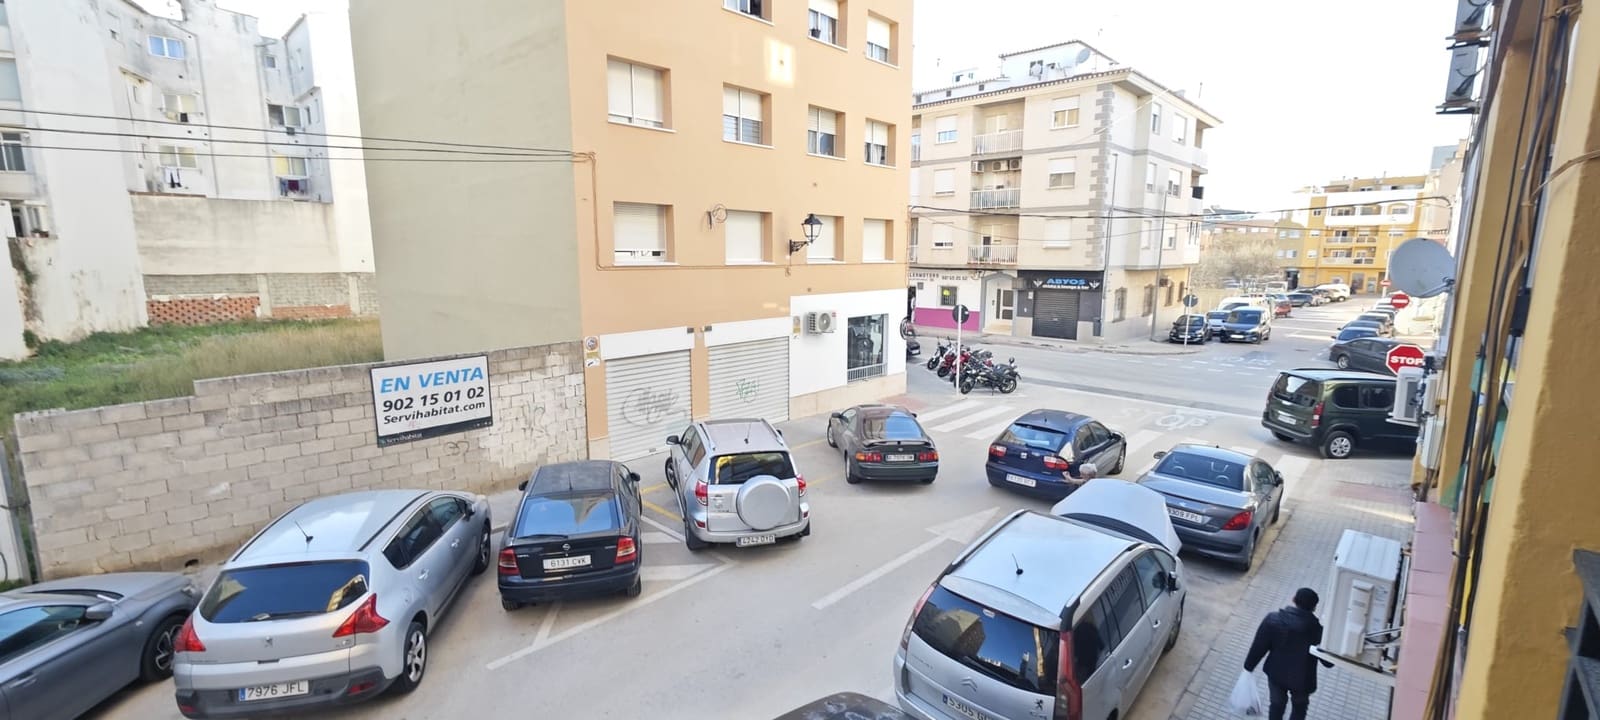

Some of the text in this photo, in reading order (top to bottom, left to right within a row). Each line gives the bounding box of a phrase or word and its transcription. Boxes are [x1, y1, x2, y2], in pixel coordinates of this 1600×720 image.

[1046, 278, 1086, 286] ABYOS
[1390, 356, 1425, 366] STOP
[380, 367, 483, 393] EN VENTA
[383, 387, 484, 412] 902 15 01 02
[384, 401, 486, 425] Servihabitat.com
[550, 559, 570, 567] 6131
[247, 682, 304, 697] 7976 JFL
